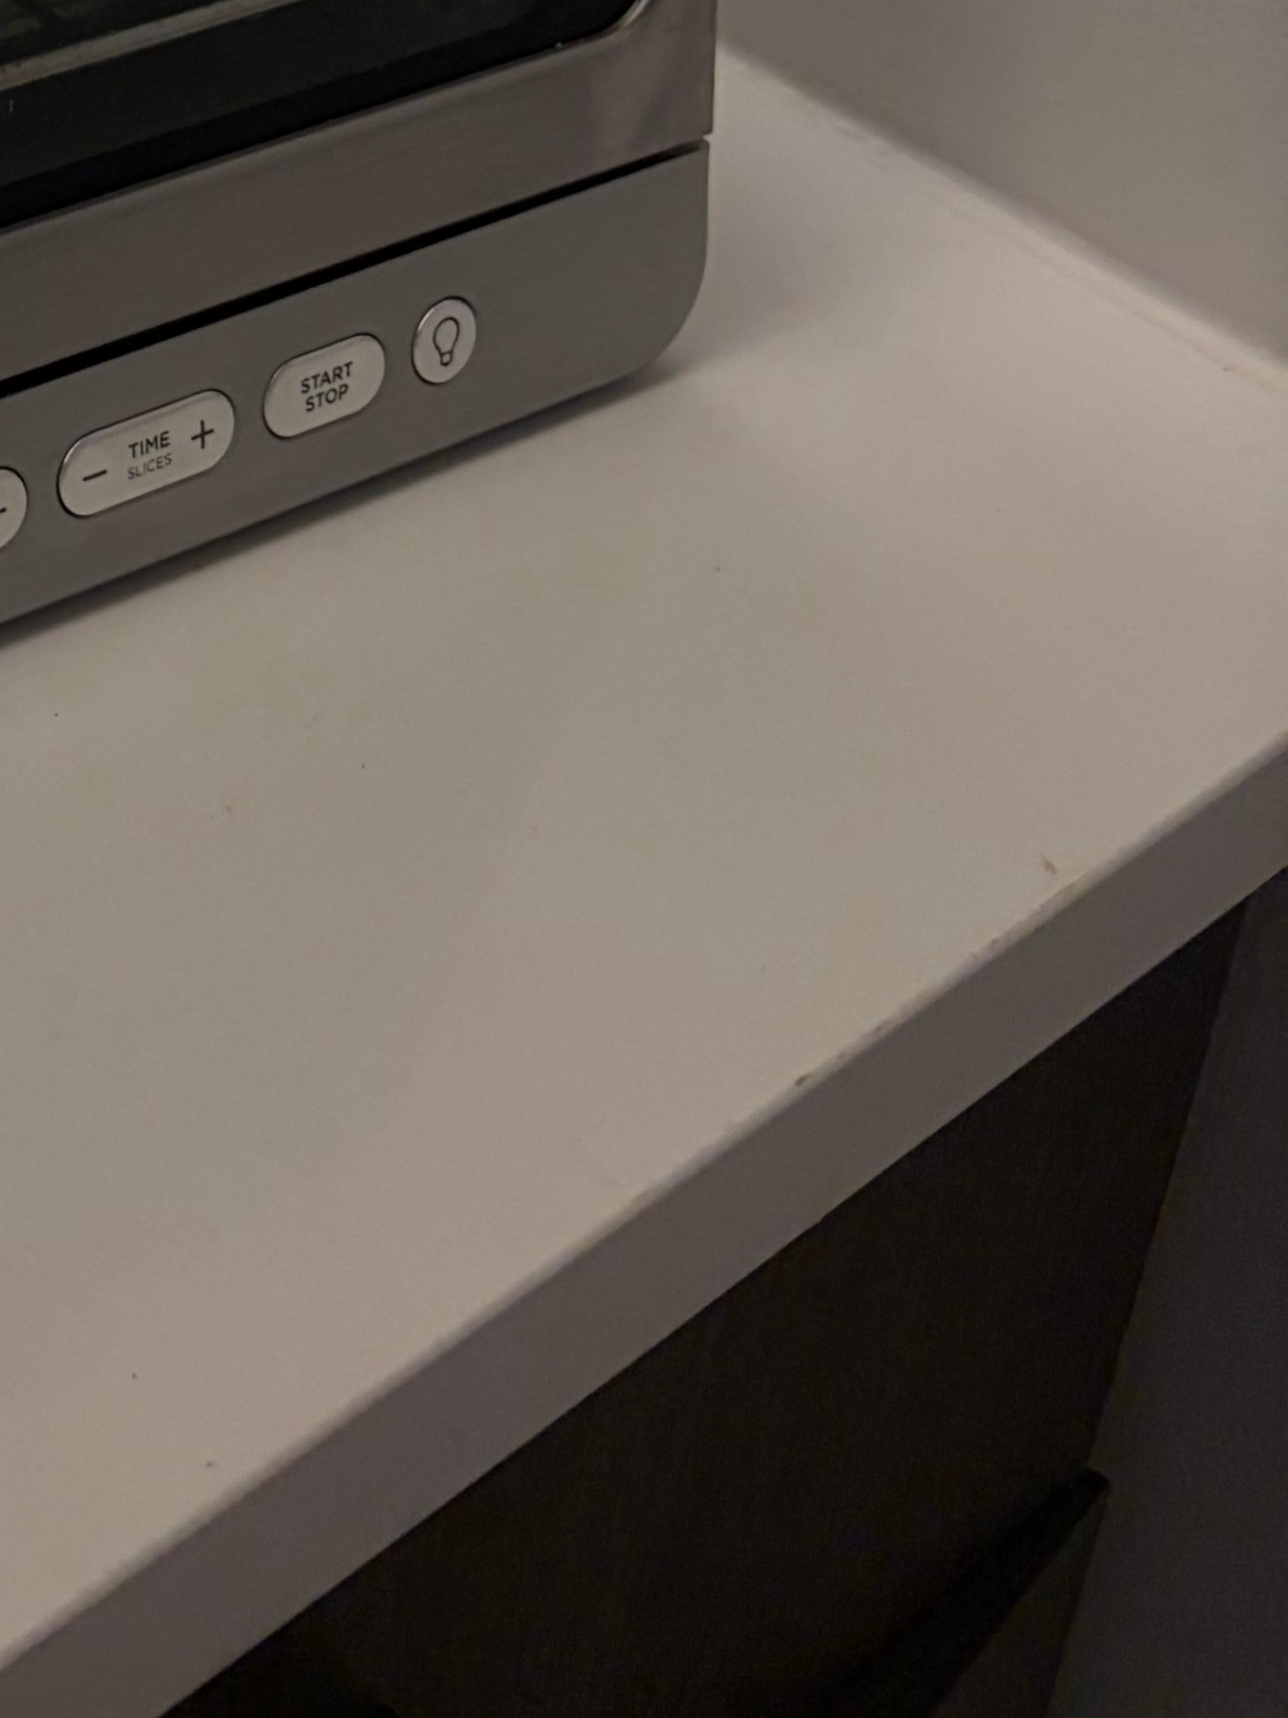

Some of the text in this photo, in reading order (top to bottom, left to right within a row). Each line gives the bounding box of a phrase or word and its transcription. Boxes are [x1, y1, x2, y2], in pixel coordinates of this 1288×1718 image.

[300, 360, 354, 395] START
[304, 383, 350, 413] STOP
[127, 429, 172, 460] TIME
[126, 452, 173, 481] SLICES
